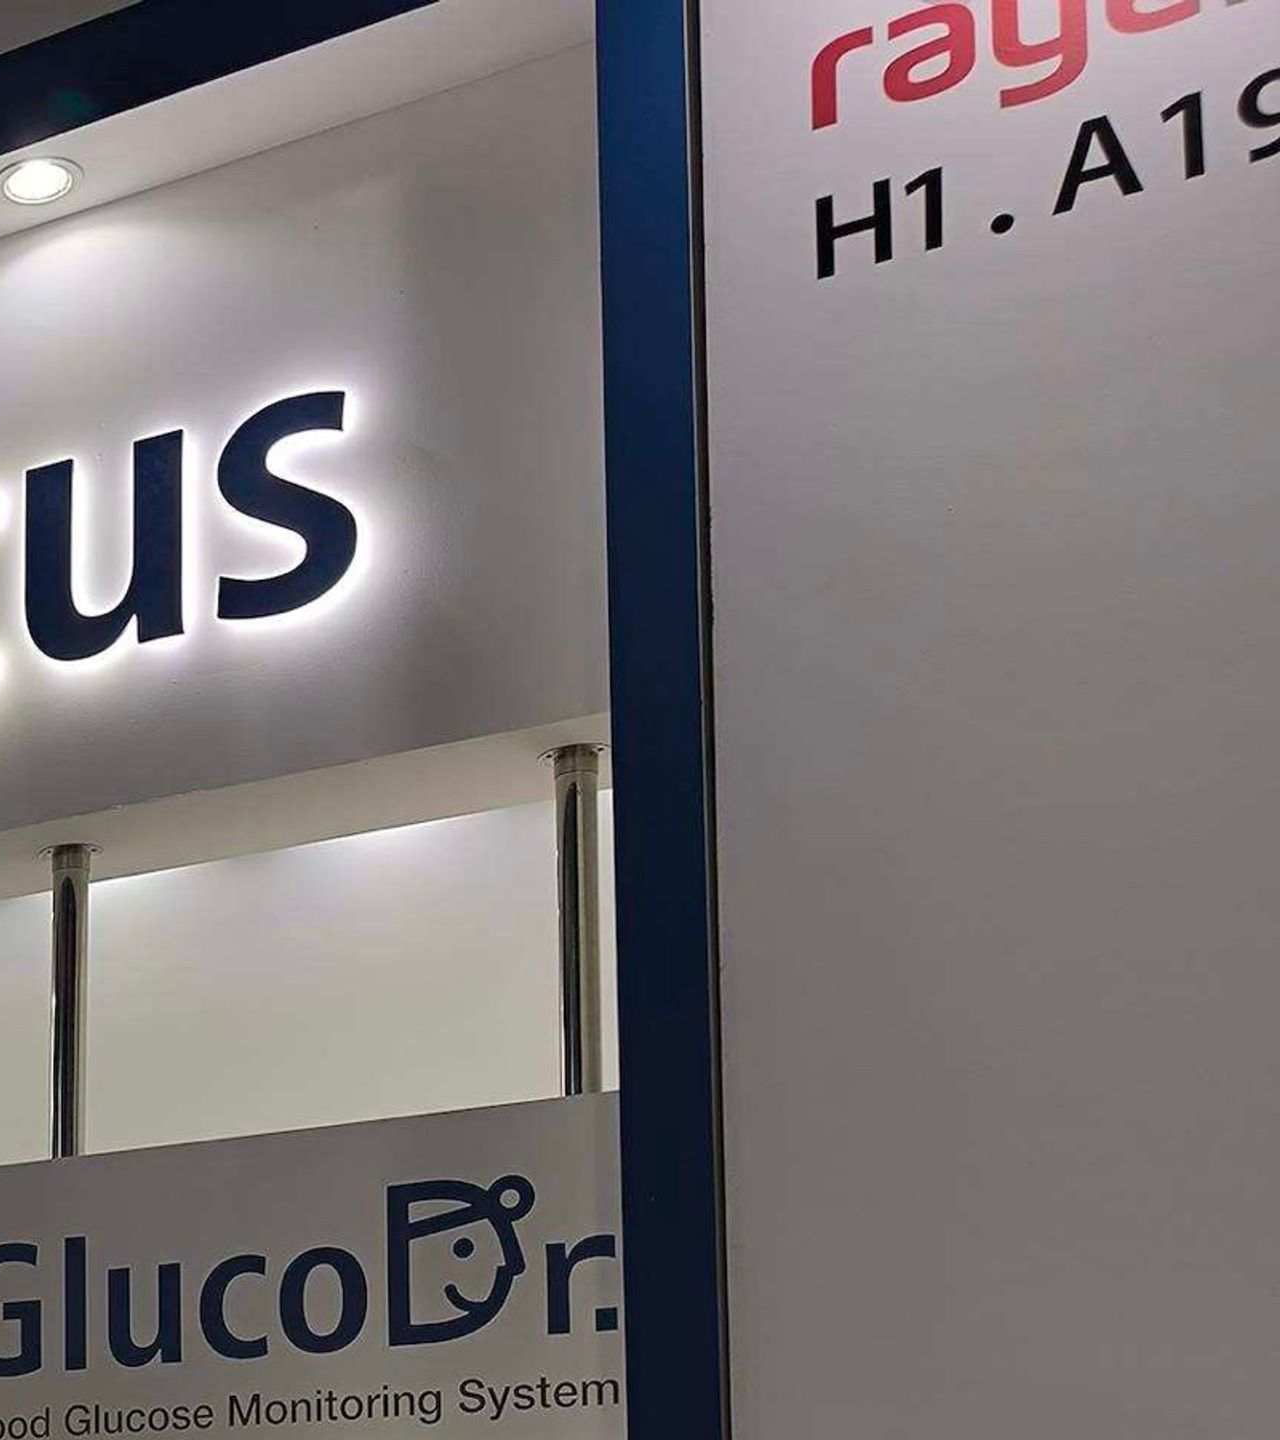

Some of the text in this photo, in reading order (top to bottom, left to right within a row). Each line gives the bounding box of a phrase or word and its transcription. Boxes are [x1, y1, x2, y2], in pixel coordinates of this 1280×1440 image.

[811, 0, 1248, 130] ray
[64, 1403, 214, 1437] Glucose
[228, 1384, 442, 1427] Monitoring
[458, 1377, 620, 1421] System
